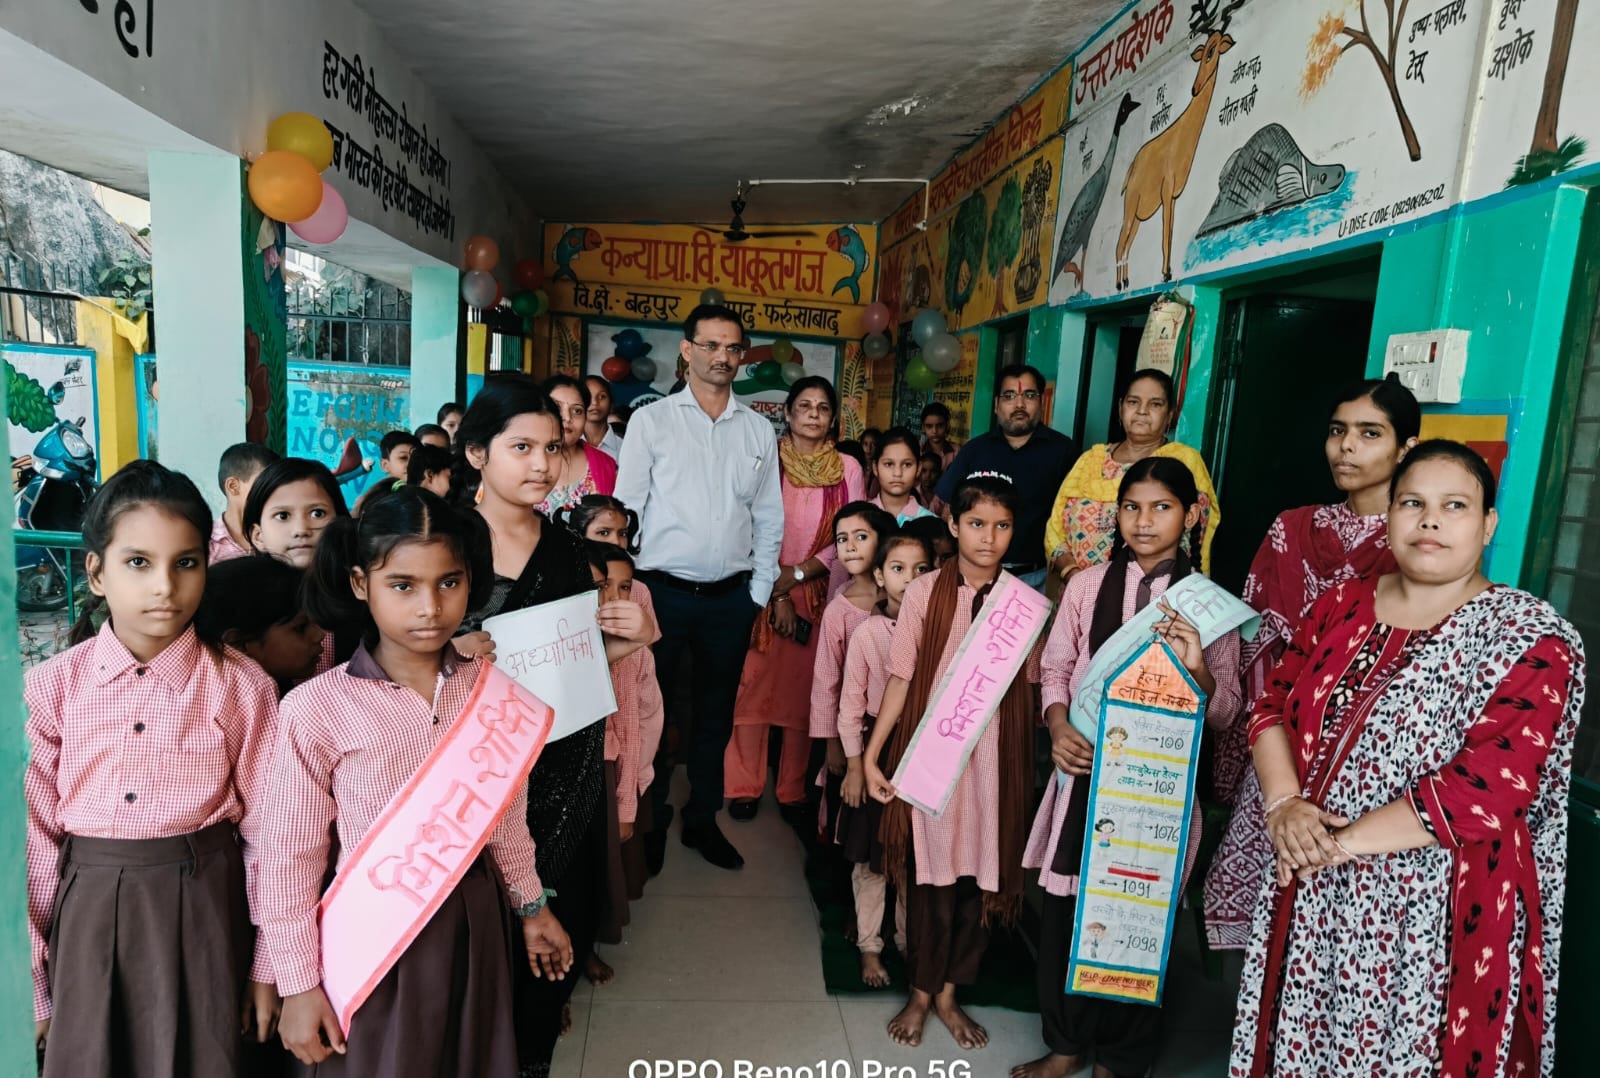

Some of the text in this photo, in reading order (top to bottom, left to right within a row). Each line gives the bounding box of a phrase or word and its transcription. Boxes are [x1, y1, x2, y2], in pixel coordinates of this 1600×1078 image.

[1406, 49, 1429, 84] टेसू
[1488, 27, 1535, 80] अशोक
[323, 40, 340, 99] हर
[340, 54, 365, 114] गली
[1075, 39, 1114, 105] उत्तर
[324, 120, 344, 172] ब
[345, 132, 372, 188] भारत
[371, 144, 384, 198] की
[382, 165, 395, 212] हर
[937, 664, 997, 741] मिशन
[1119, 686, 1161, 705] लाइन
[1160, 736, 1184, 750] 100
[1154, 780, 1176, 795] 108
[367, 778, 492, 906] मिशन
[1154, 823, 1180, 842] 1076
[1122, 879, 1151, 898] 1091
[1126, 934, 1157, 953] 1098
[1080, 970, 1099, 980] HELP
